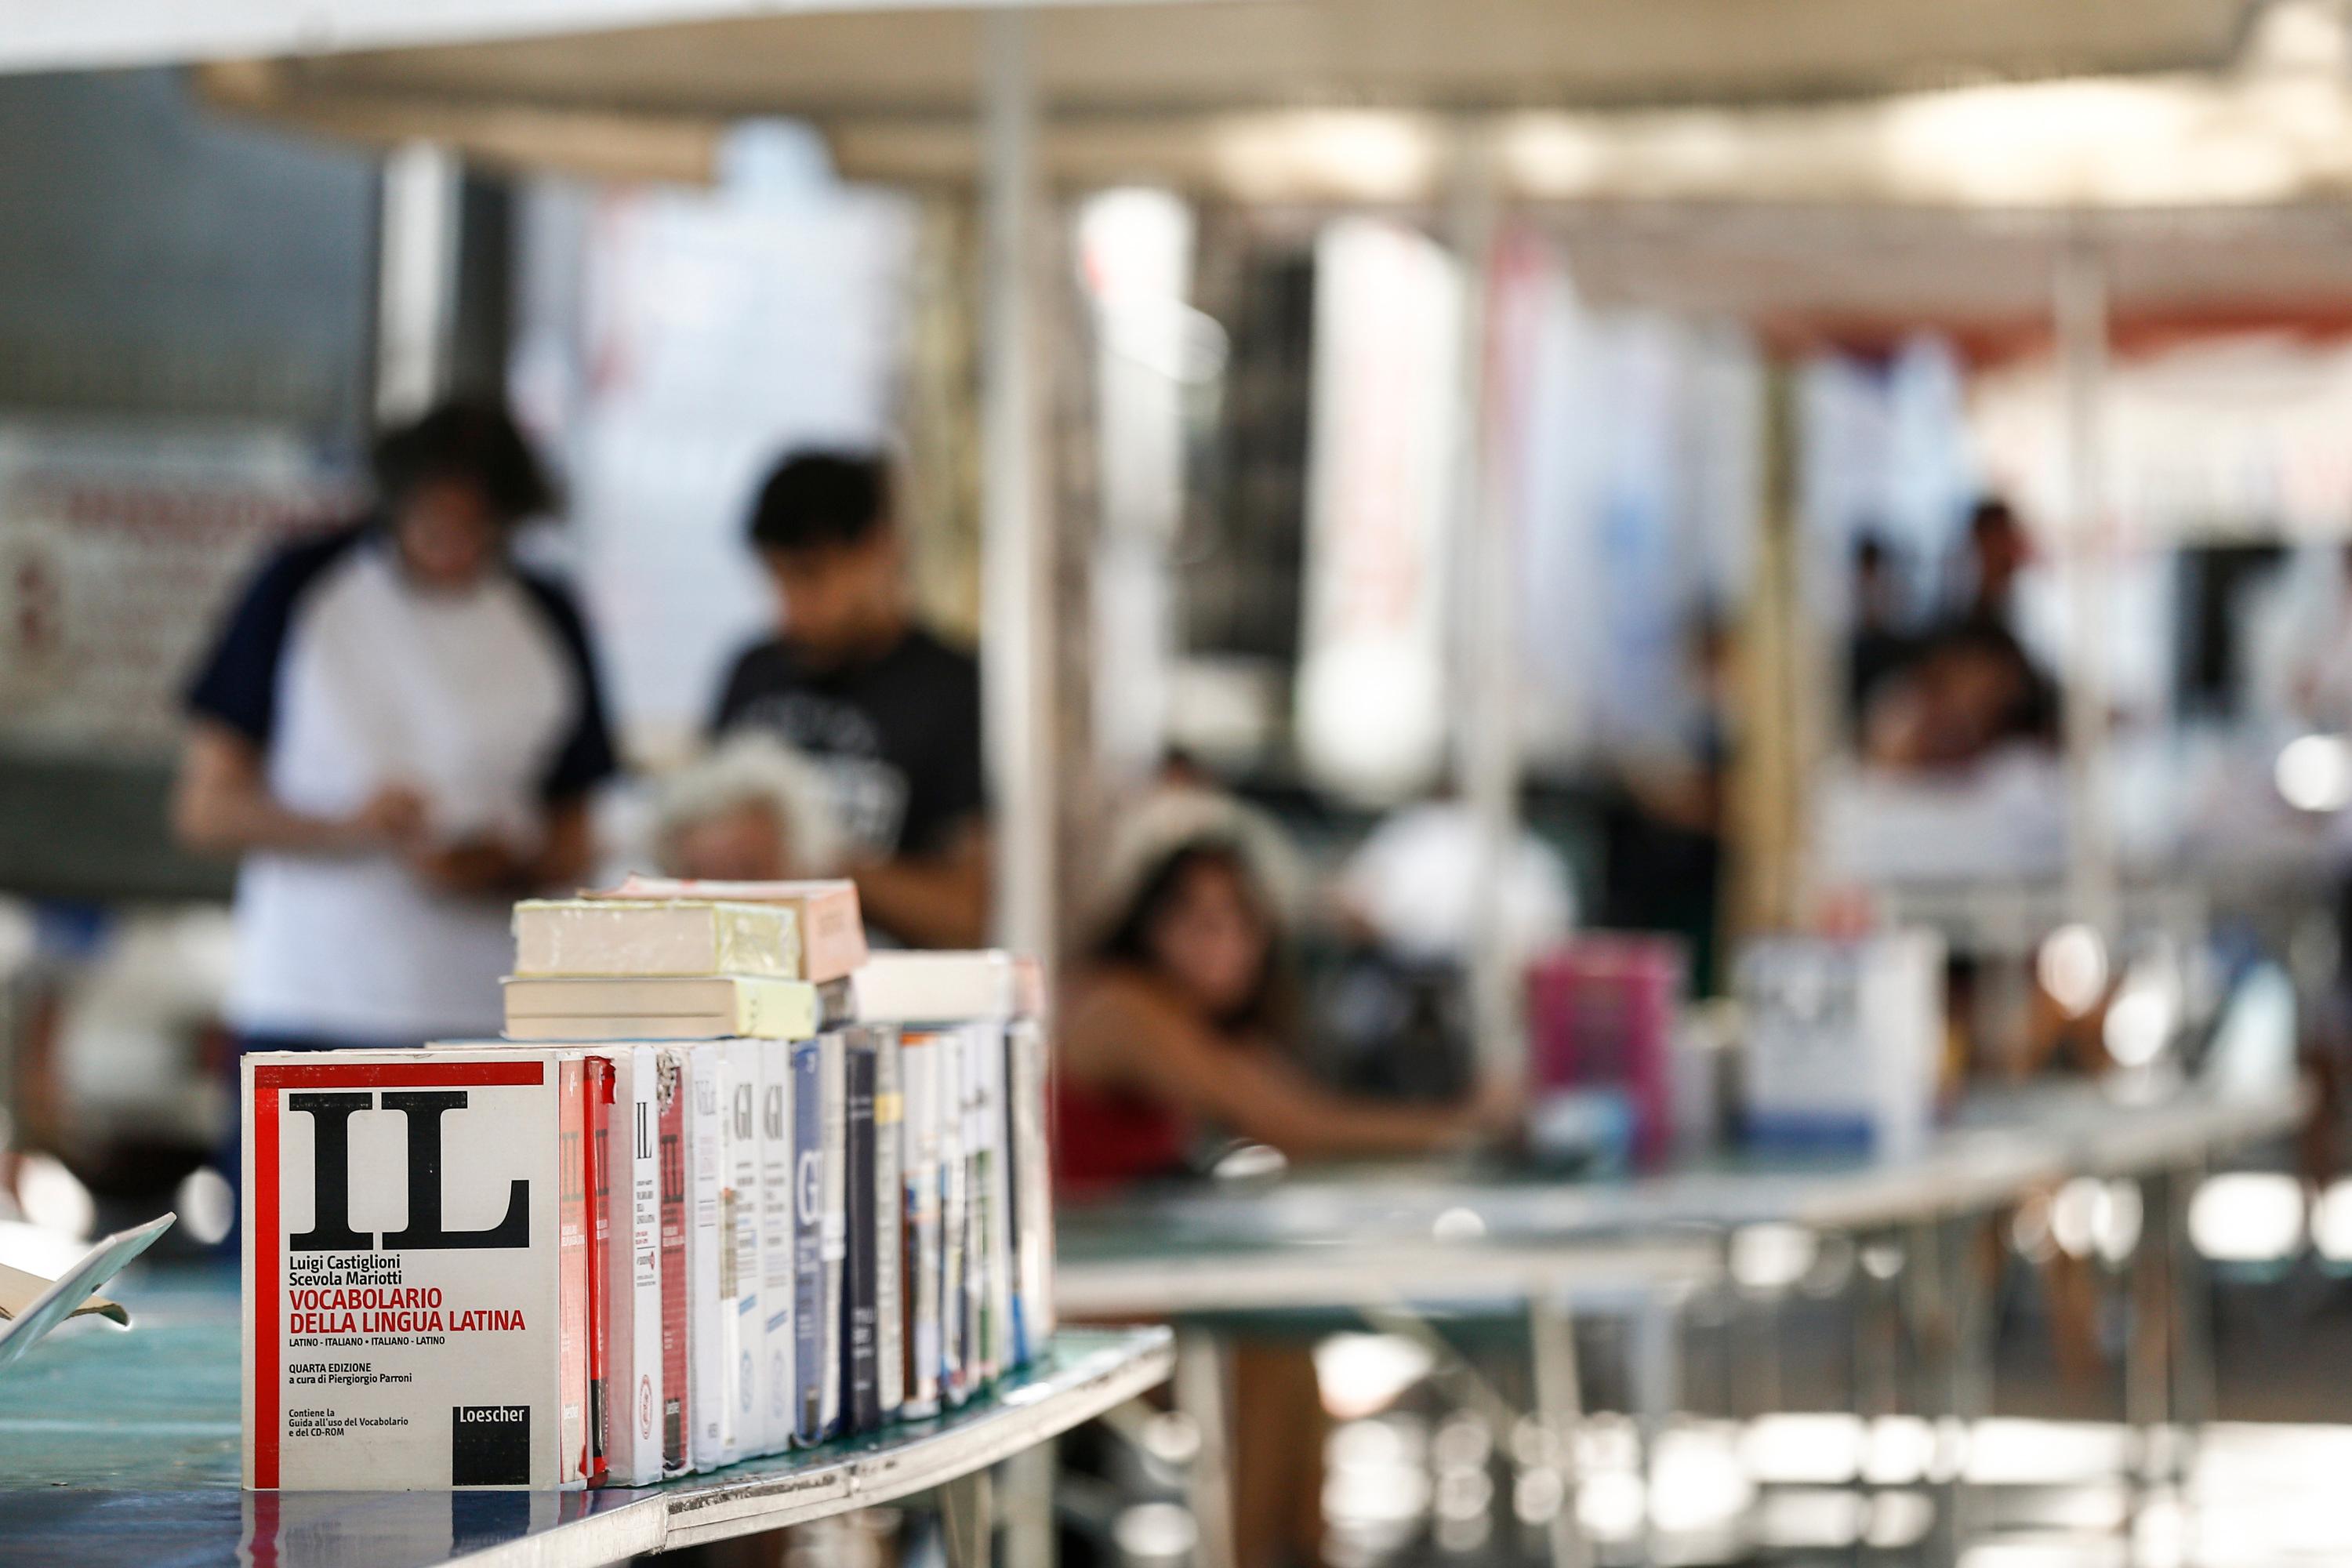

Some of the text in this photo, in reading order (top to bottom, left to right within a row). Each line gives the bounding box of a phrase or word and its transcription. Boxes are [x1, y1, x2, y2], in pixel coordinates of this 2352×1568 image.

[636, 1102, 652, 1160] IL
[289, 1091, 529, 1250] IL
[662, 1134, 684, 1203] IL
[289, 1254, 401, 1273] Luigi Castiglioni
[289, 1270, 402, 1287] Scevola Mariotti
[289, 1288, 443, 1311] VOCABOLARIO
[290, 1309, 526, 1334] DELLA LINGUA LATINA
[289, 1338, 318, 1347] LATINO
[325, 1337, 363, 1346] ITALIANO
[371, 1336, 409, 1345] ITALIANO
[416, 1336, 445, 1345] LATINO
[289, 1363, 372, 1374] QUARTA EDIZIONE
[318, 1374, 326, 1384] di
[328, 1374, 378, 1386] Piergiorgio
[379, 1372, 412, 1383] Parroni
[289, 1408, 335, 1417] Contiene la
[459, 1406, 525, 1423] Loescher
[289, 1417, 408, 1428] Guida all'uso del Vocabolario
[296, 1428, 309, 1437] del
[310, 1428, 345, 1437] CD-ROM
